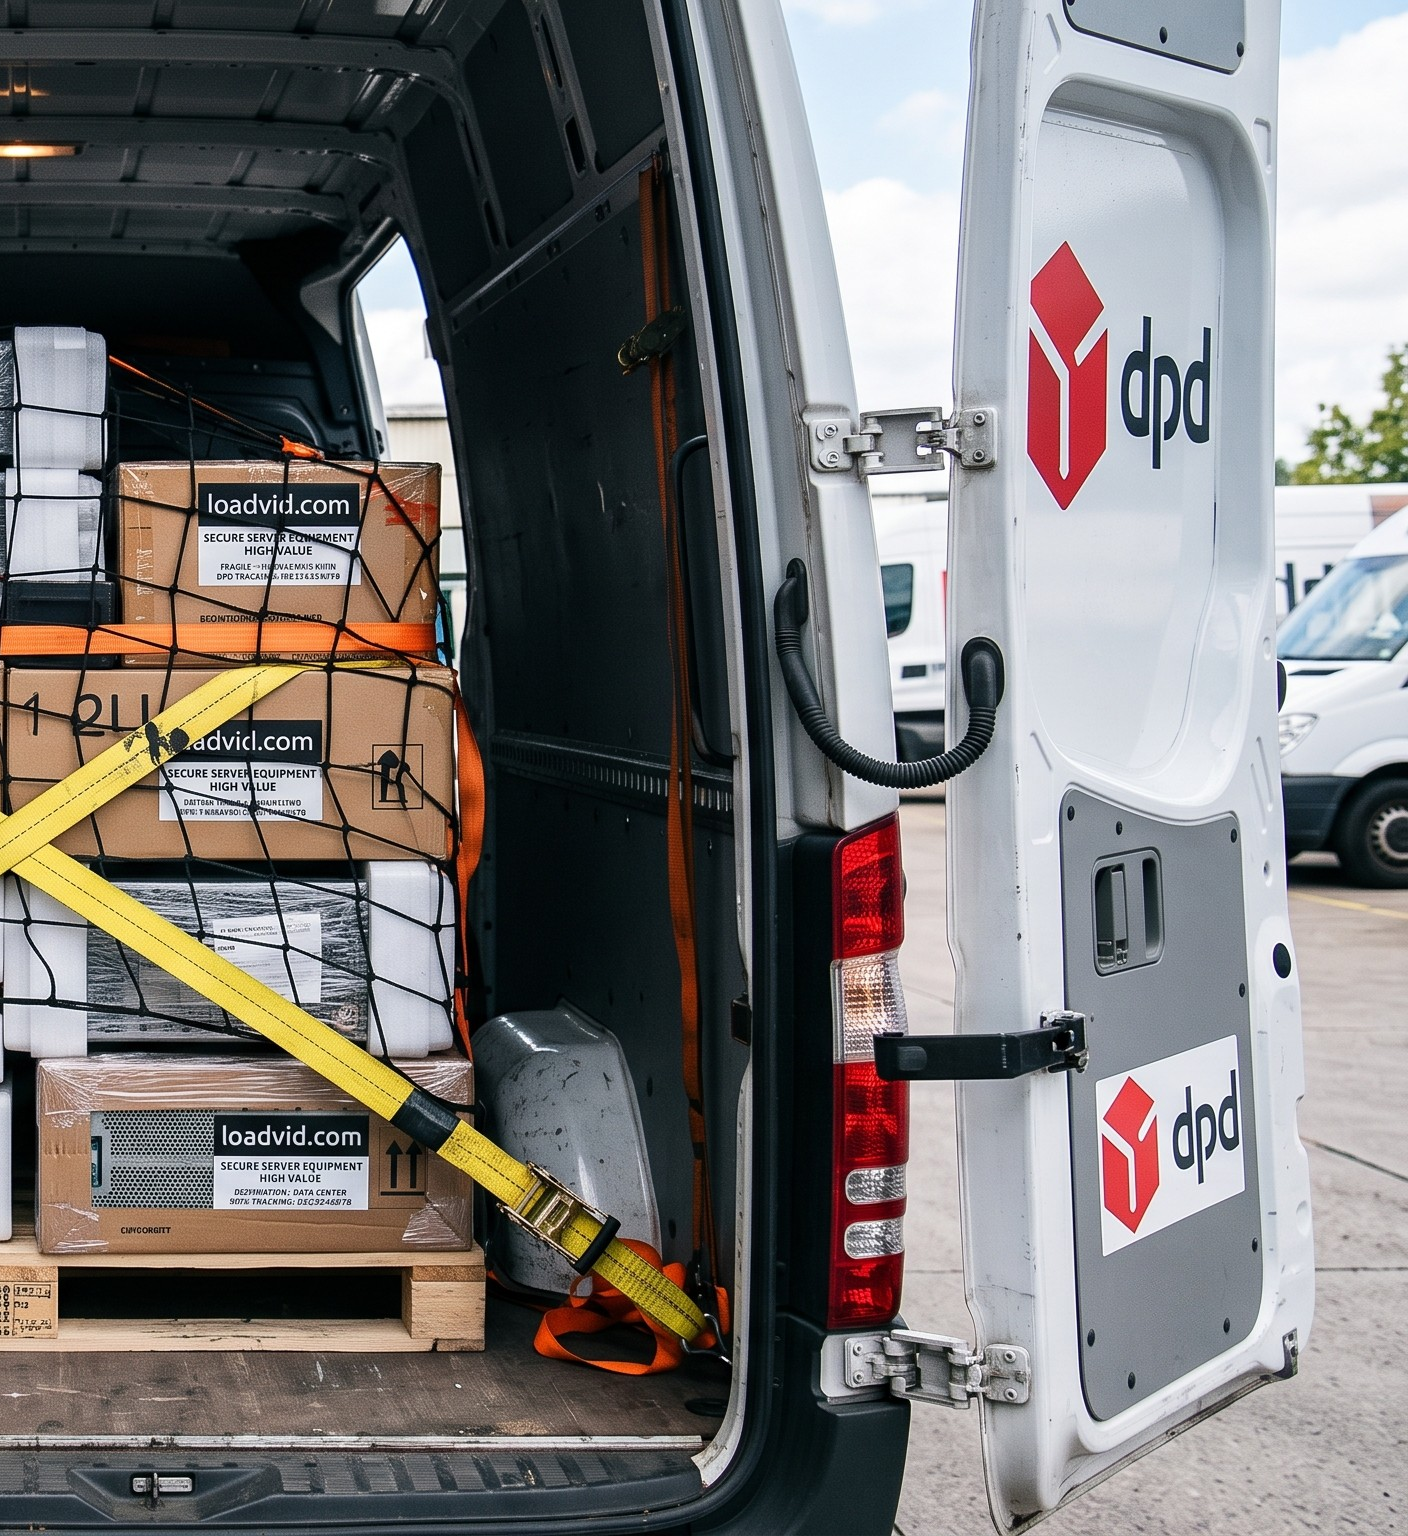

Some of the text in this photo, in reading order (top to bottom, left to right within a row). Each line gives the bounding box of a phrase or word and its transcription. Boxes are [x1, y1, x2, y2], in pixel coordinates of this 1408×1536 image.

[1121, 316, 1211, 469] dpd
[207, 493, 350, 515] loadvid.com
[203, 533, 245, 543] SECURE
[244, 546, 313, 556] HIGH VALUE
[190, 730, 314, 751] advid.com
[167, 769, 208, 779] SECURE
[253, 769, 317, 779] EQUIPMENT
[209, 782, 239, 792] HIGH
[1172, 1069, 1240, 1185] dpd
[222, 1125, 362, 1147] loadvid.com
[220, 1161, 363, 1173] SECURE SERVER EQUIPMENT
[259, 1174, 287, 1183] HIGH
[292, 1189, 314, 1197] DATA
[315, 1189, 347, 1197] CENTER
